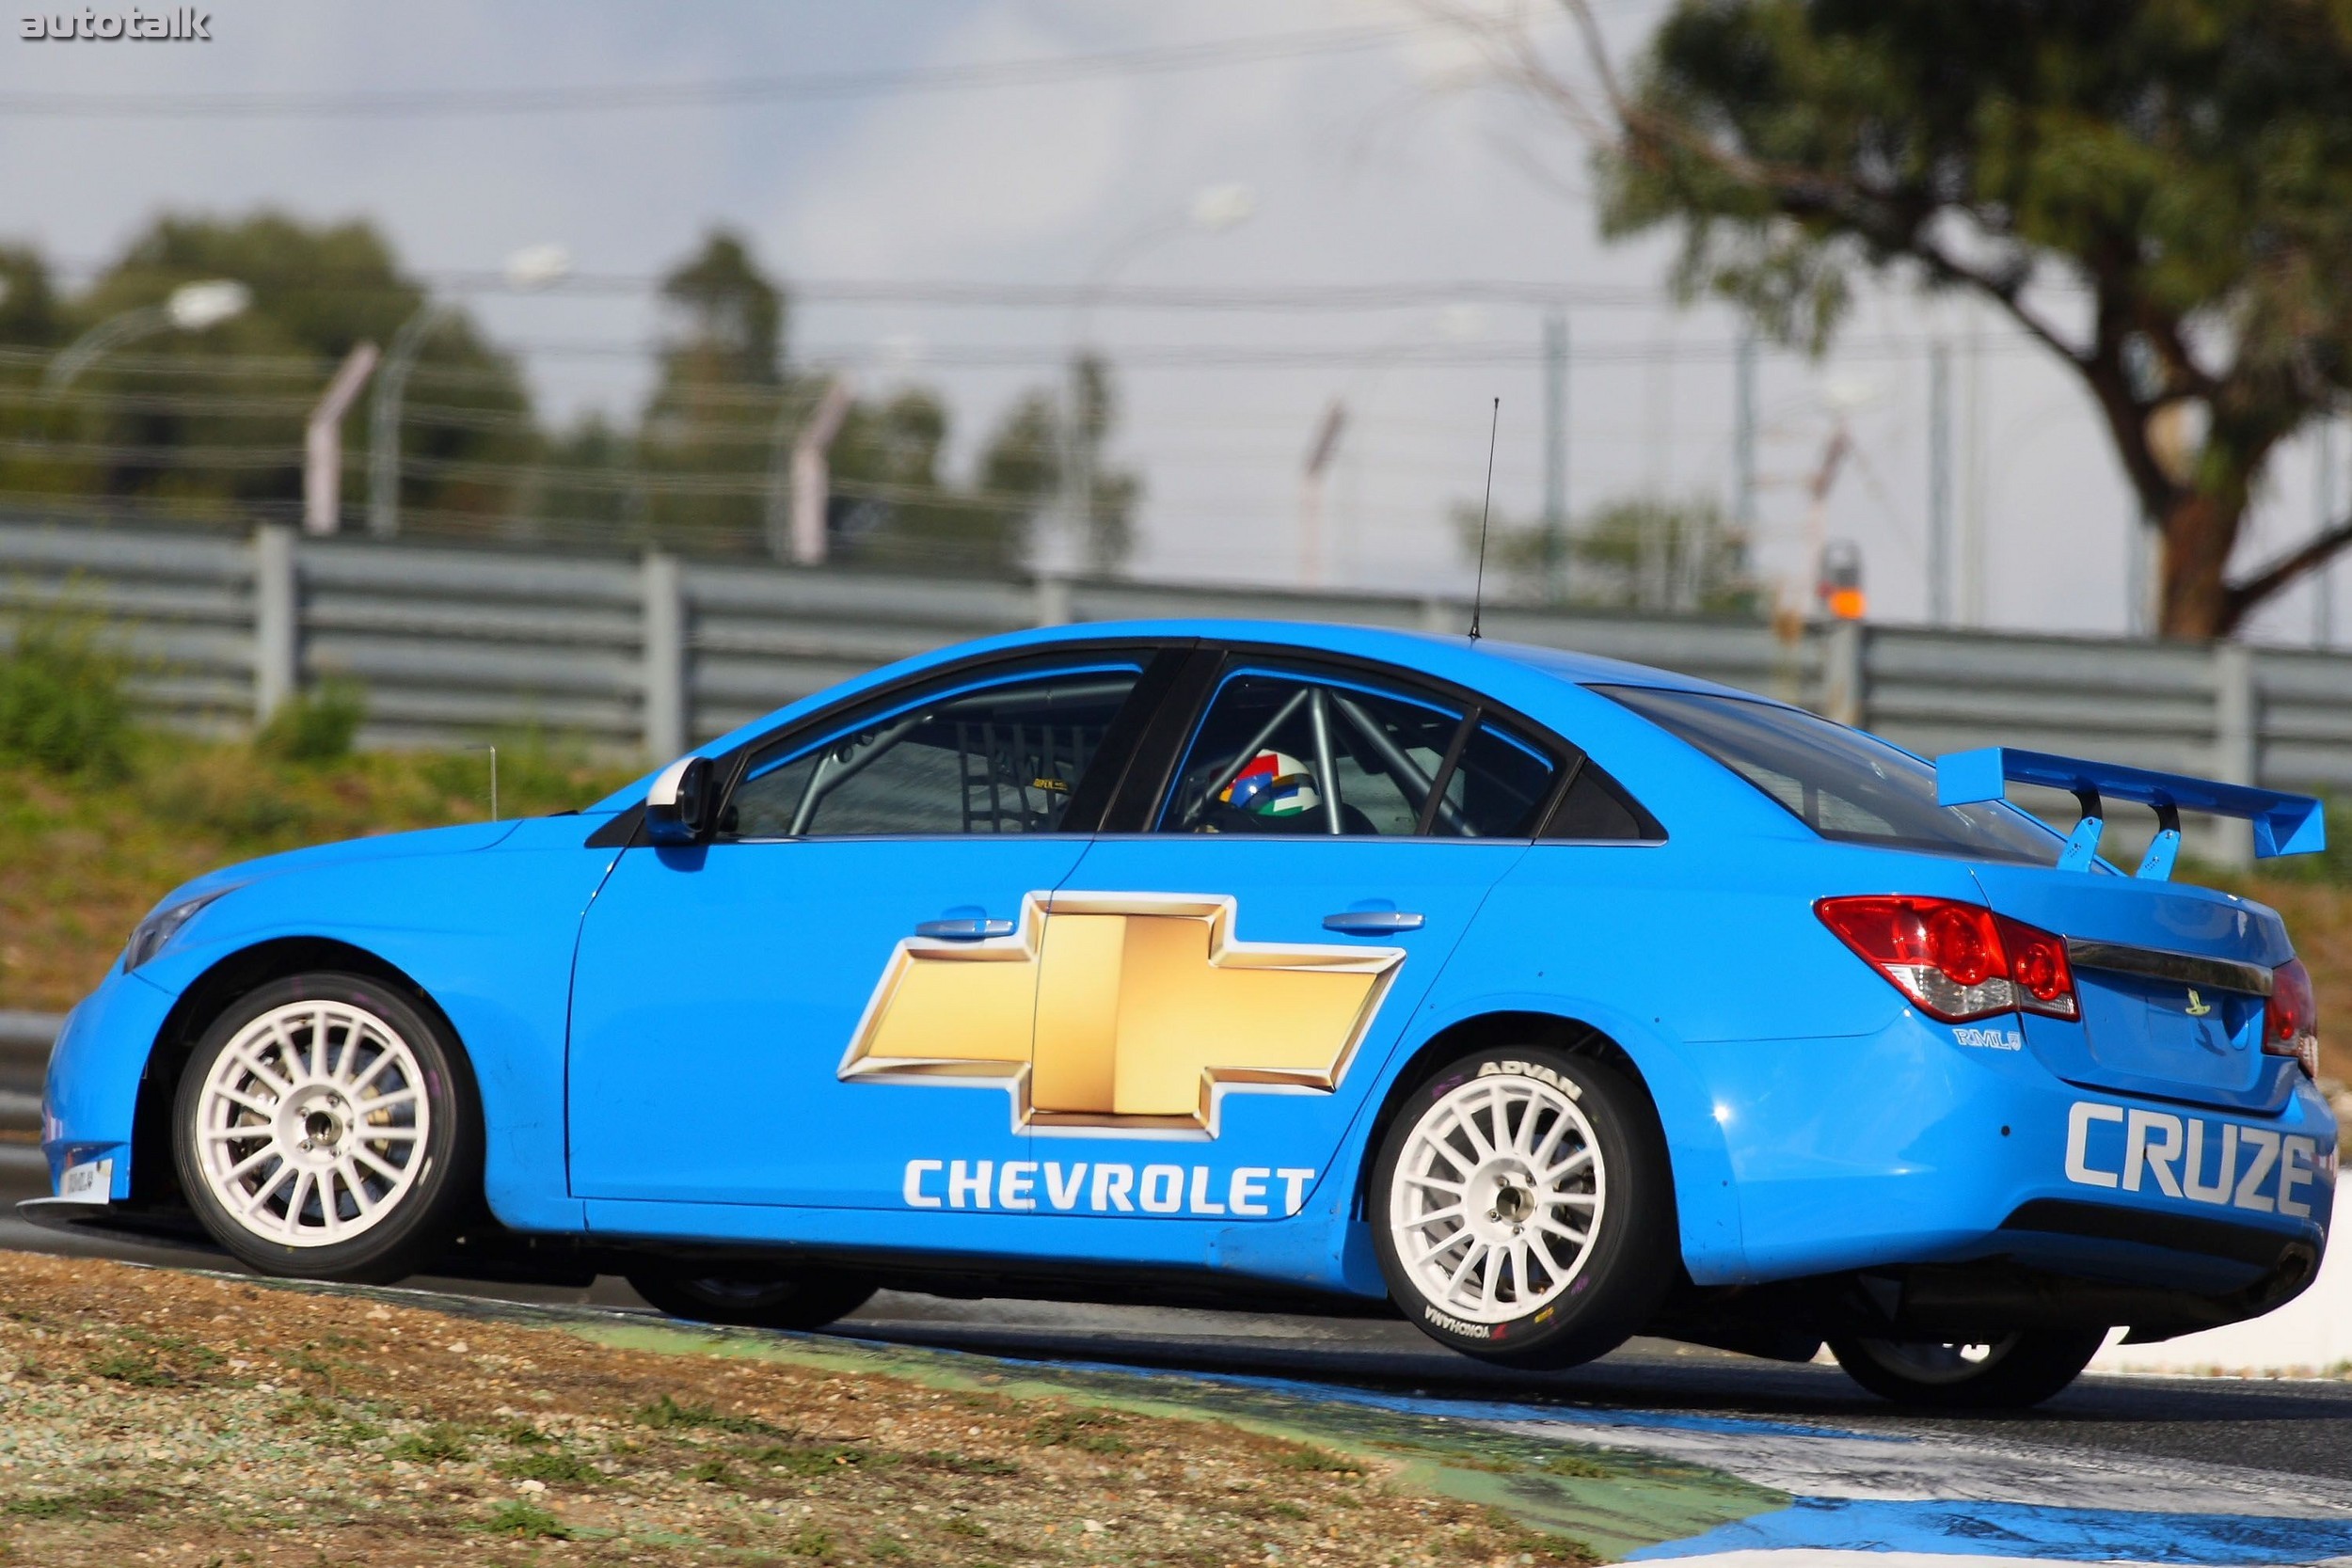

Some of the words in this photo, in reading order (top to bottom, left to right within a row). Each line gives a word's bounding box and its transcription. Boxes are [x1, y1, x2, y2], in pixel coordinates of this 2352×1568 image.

[1952, 1028, 2011, 1051] RML
[1476, 1060, 1583, 1101] ADVAN
[2065, 1101, 2316, 1217] CRUZE
[902, 1159, 1315, 1216] CHEVROLET
[1424, 1305, 1490, 1338] YOKOHAMA
